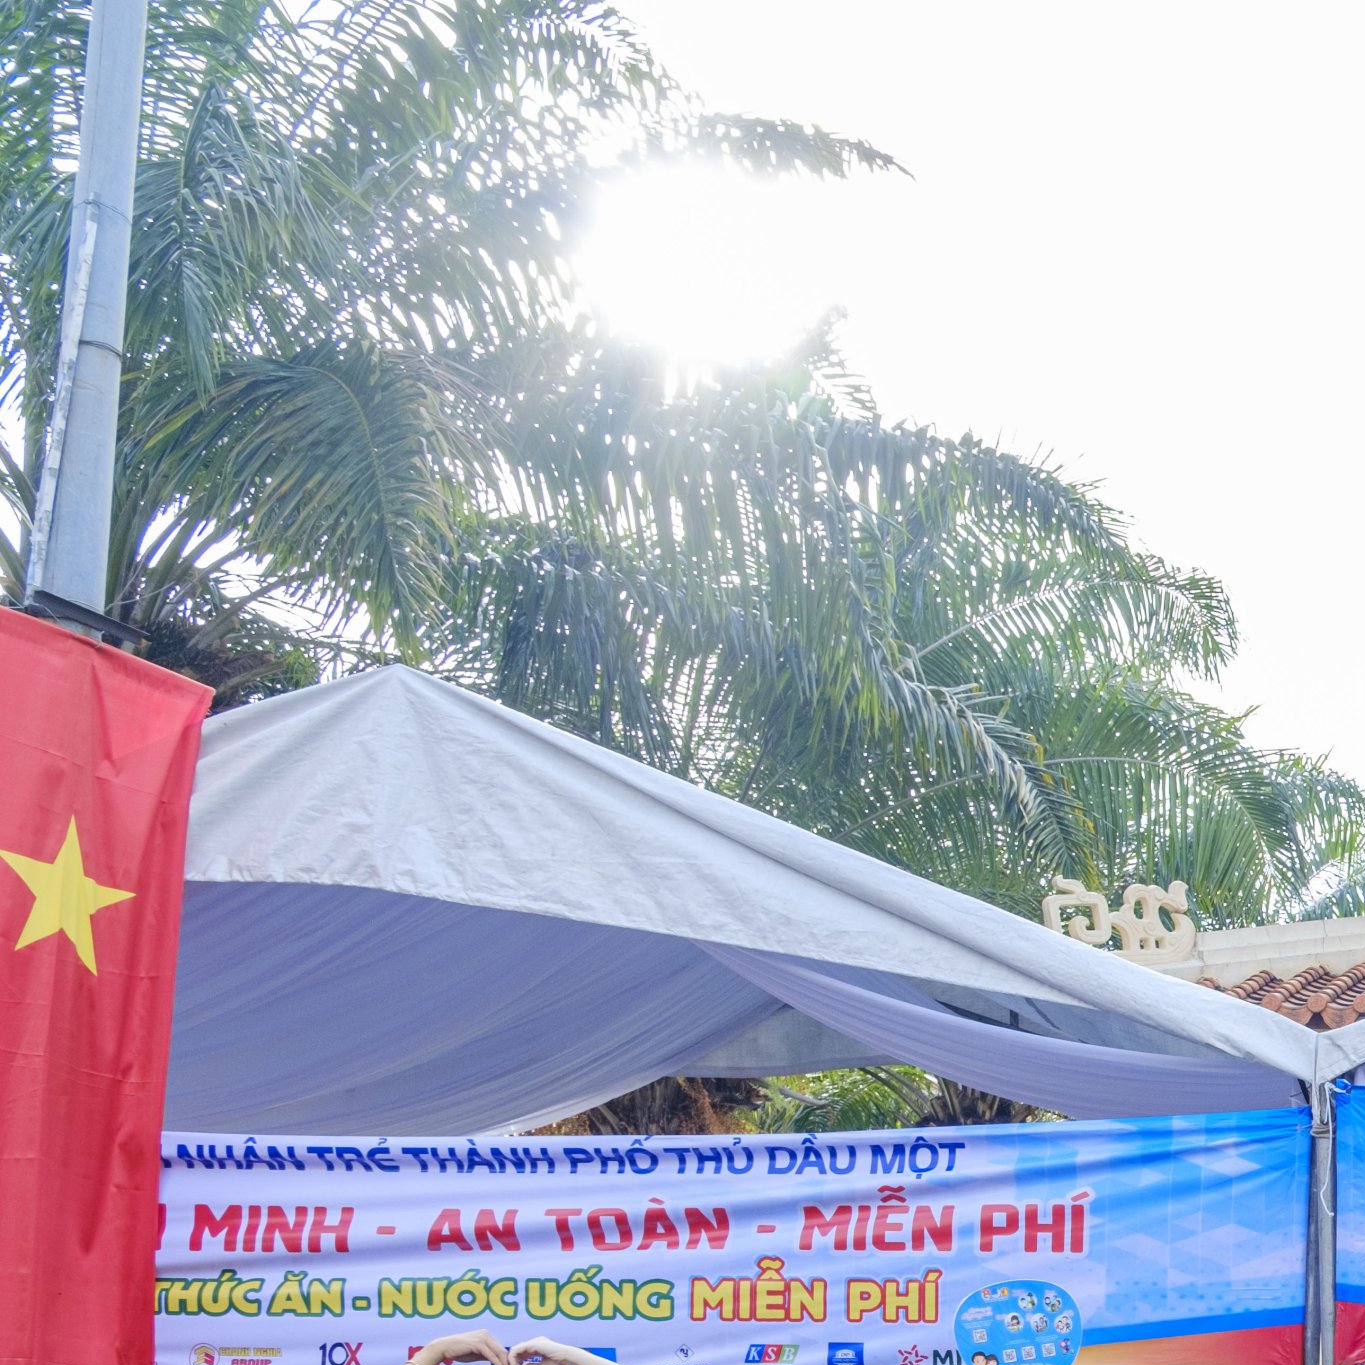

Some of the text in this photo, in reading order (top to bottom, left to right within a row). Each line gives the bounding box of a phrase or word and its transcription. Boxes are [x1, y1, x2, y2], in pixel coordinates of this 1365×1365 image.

[177, 1136, 303, 1172] NHÂN
[307, 1137, 400, 1173] TRẺ
[402, 1136, 556, 1175] THÀNH
[561, 1133, 660, 1175] PHỐ
[663, 1136, 754, 1175] THỦ
[767, 1132, 858, 1175] DẦU
[869, 1135, 966, 1181] MỘT
[189, 1203, 354, 1253] MINH
[426, 1209, 521, 1252] AN
[545, 1197, 729, 1252] TOÀN
[798, 1184, 954, 1253] MIỄN
[979, 1190, 1092, 1254] PHÍ
[266, 1269, 347, 1318] ĂN
[377, 1267, 519, 1320] NƯỚC
[524, 1264, 676, 1322] UỐNG
[690, 1254, 828, 1324] MIỄN
[845, 1268, 944, 1324] PHÍ
[748, 1345, 796, 1363] KSB
